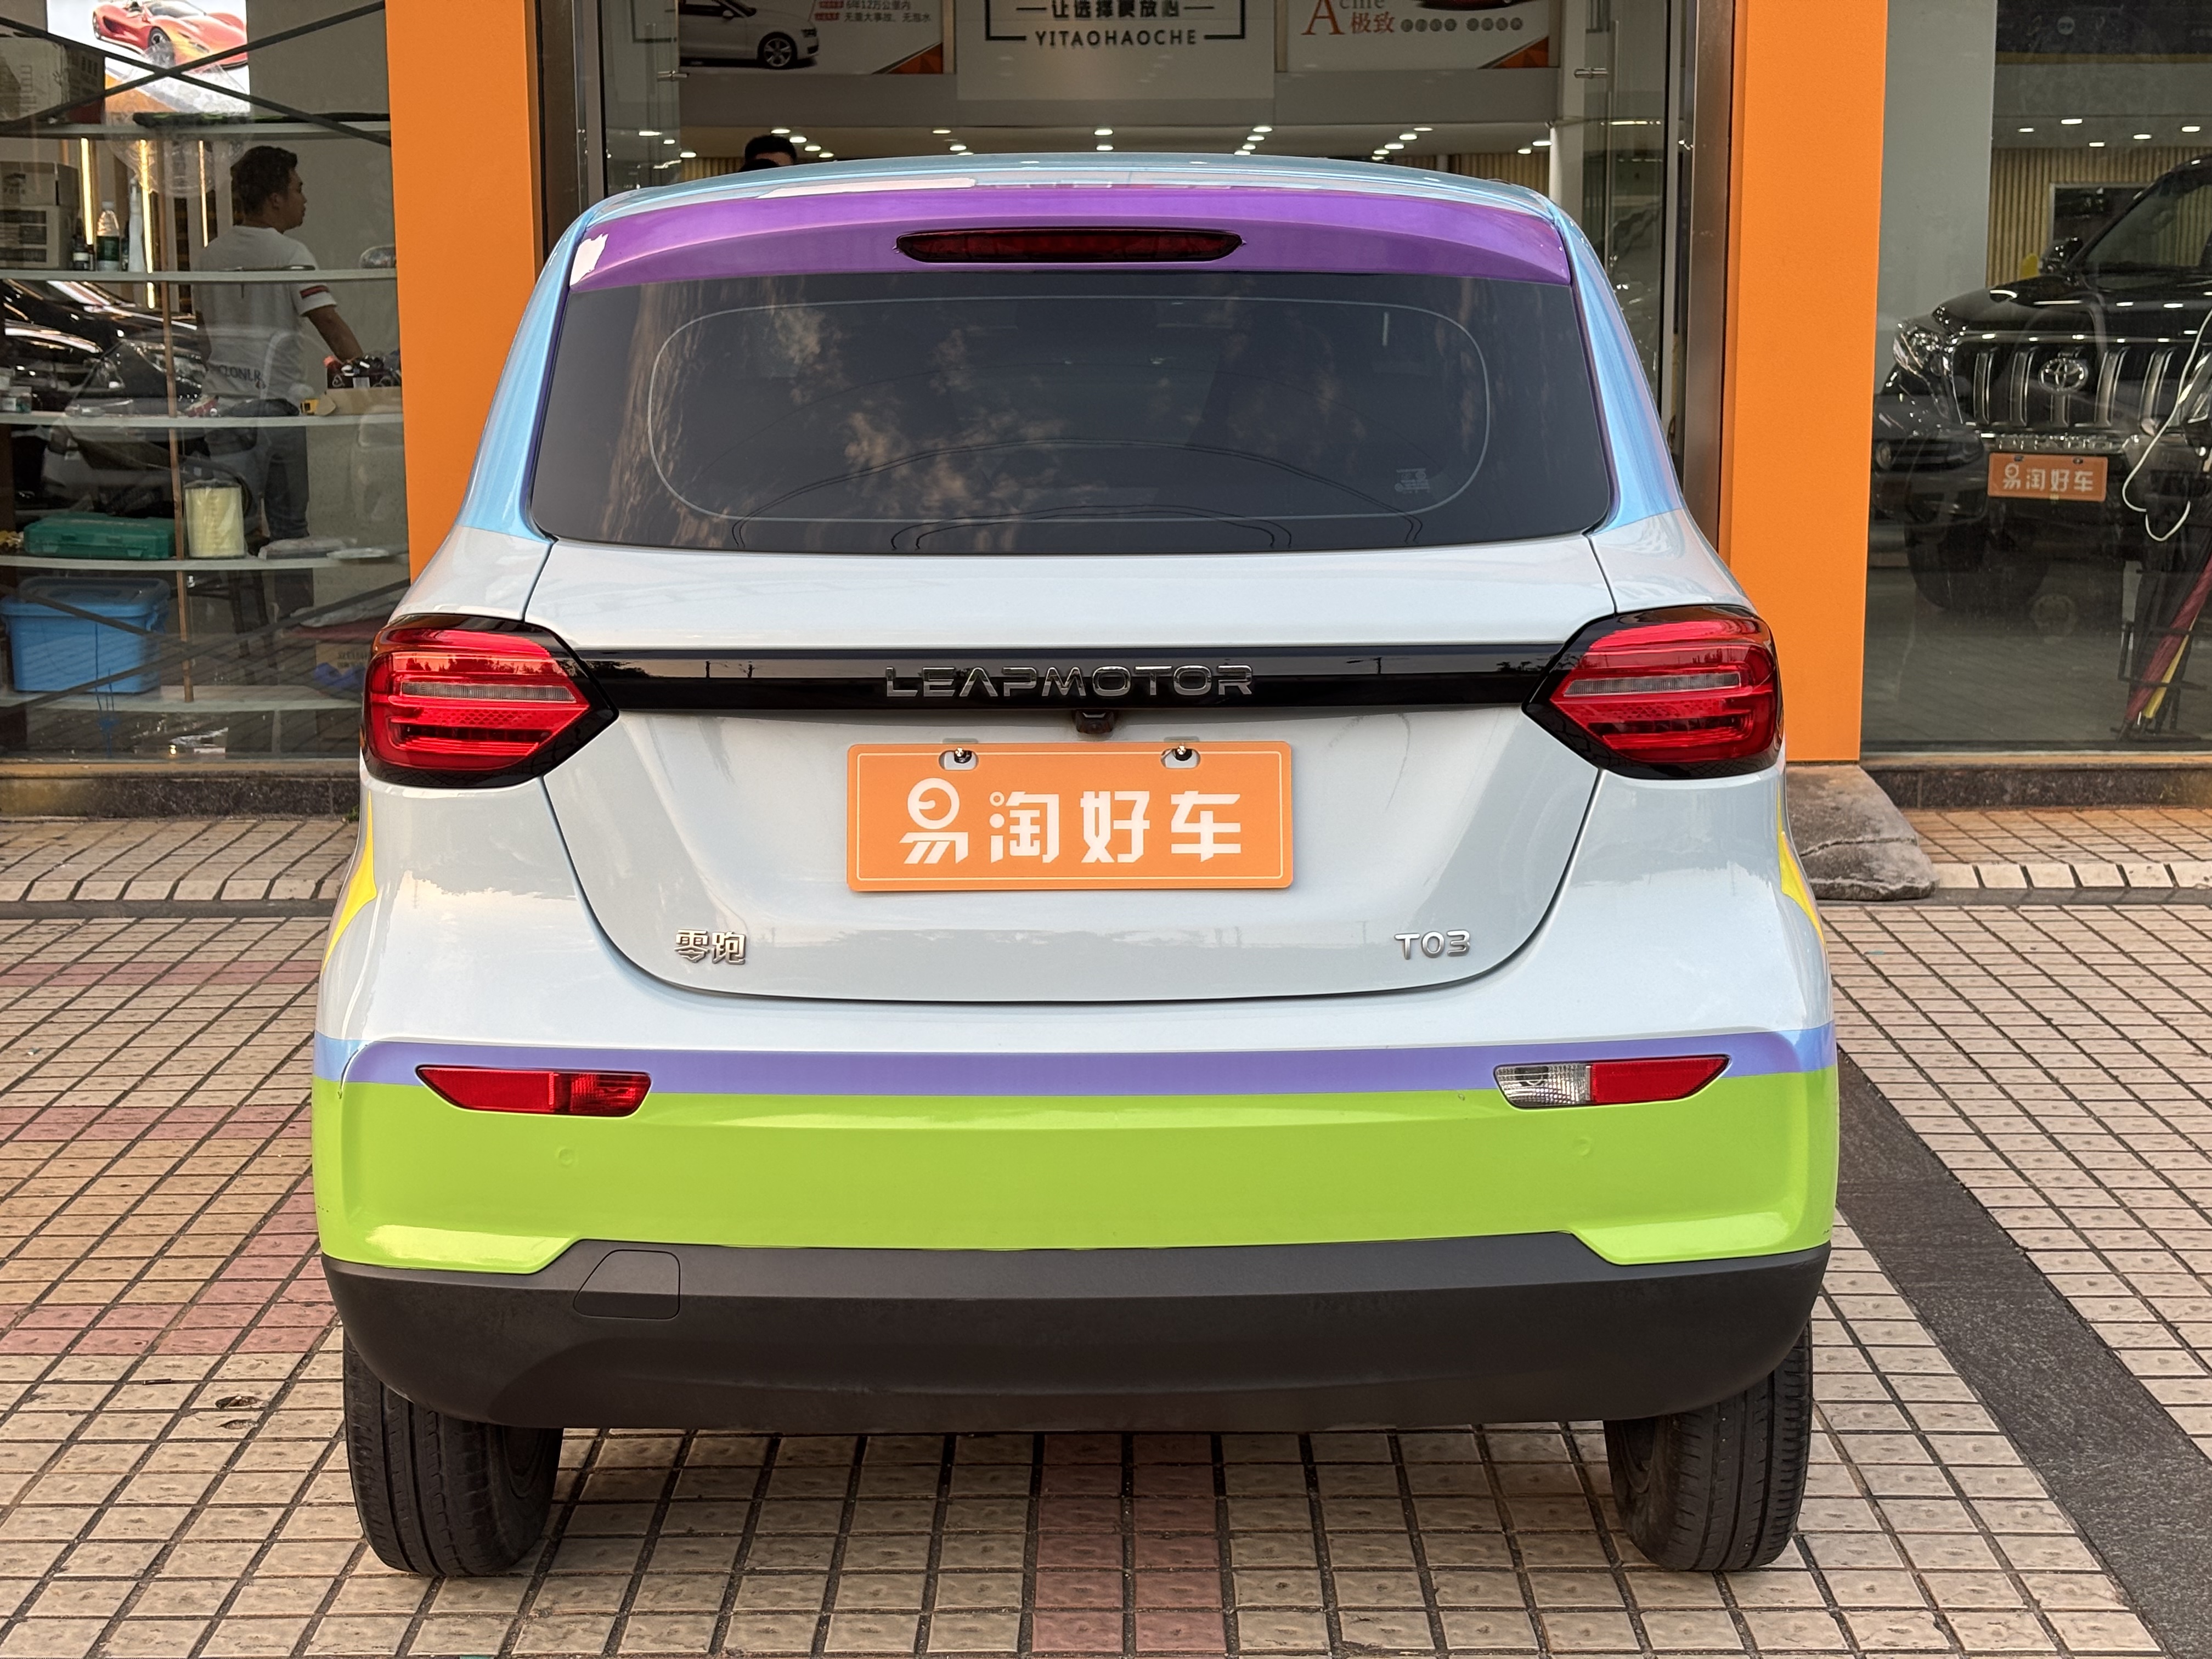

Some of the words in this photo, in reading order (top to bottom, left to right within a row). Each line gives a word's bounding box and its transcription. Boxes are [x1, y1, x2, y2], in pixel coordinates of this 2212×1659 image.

[1035, 30, 1197, 46] YITAOHAOCHE
[1350, 11, 1395, 34] 极致
[2003, 462, 2094, 492] 易淘好车
[885, 664, 1253, 698] LEAPMOTOR
[899, 777, 1242, 865] 易淘好车
[674, 929, 746, 964] 零跑
[1394, 929, 1471, 960] T03
